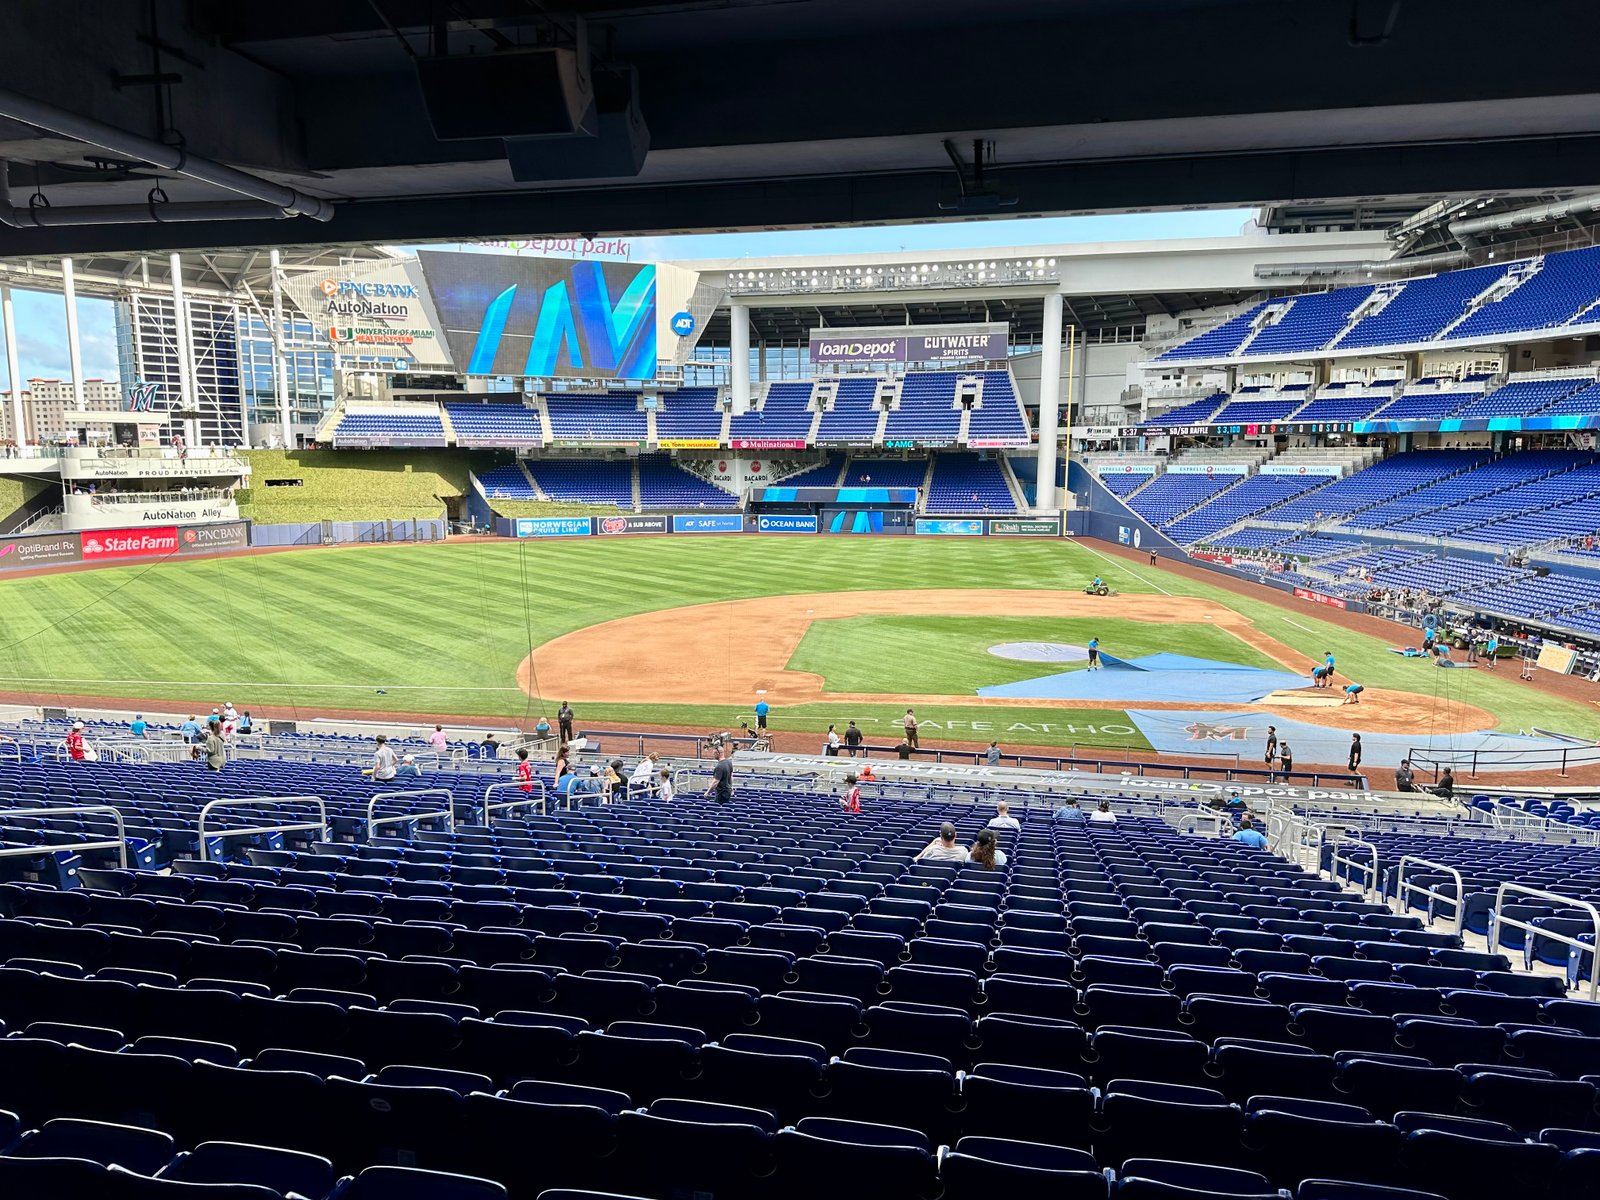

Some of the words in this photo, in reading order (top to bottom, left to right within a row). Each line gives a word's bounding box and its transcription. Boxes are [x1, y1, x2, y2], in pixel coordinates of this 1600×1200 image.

[582, 239, 627, 256] park
[376, 283, 418, 298] BANK
[328, 300, 408, 315] AutoNation
[675, 318, 693, 329] ADT
[355, 327, 397, 336] UNIVERSITY
[411, 329, 435, 337] MIAMI
[924, 335, 988, 348] CUTWATER
[818, 340, 896, 357] loanDepot
[943, 349, 969, 357] SPIRITS
[1189, 426, 1209, 435] RAFFLE
[749, 440, 797, 448] Multinational
[895, 440, 913, 448] AMG
[138, 469, 170, 477] PROUD
[142, 510, 197, 521] AutoNation
[201, 508, 222, 518] Alley
[533, 520, 589, 528] NORWEGIAN
[770, 520, 795, 528] OCEAN
[198, 529, 221, 541] PNC
[221, 527, 245, 539] BANK
[18, 542, 60, 554] OptiBrand
[62, 541, 75, 550] Rx
[891, 719, 993, 732] SAFE
[1007, 722, 1053, 733] AT
[1119, 776, 1300, 798] loanDepot
[1307, 789, 1386, 802] park
